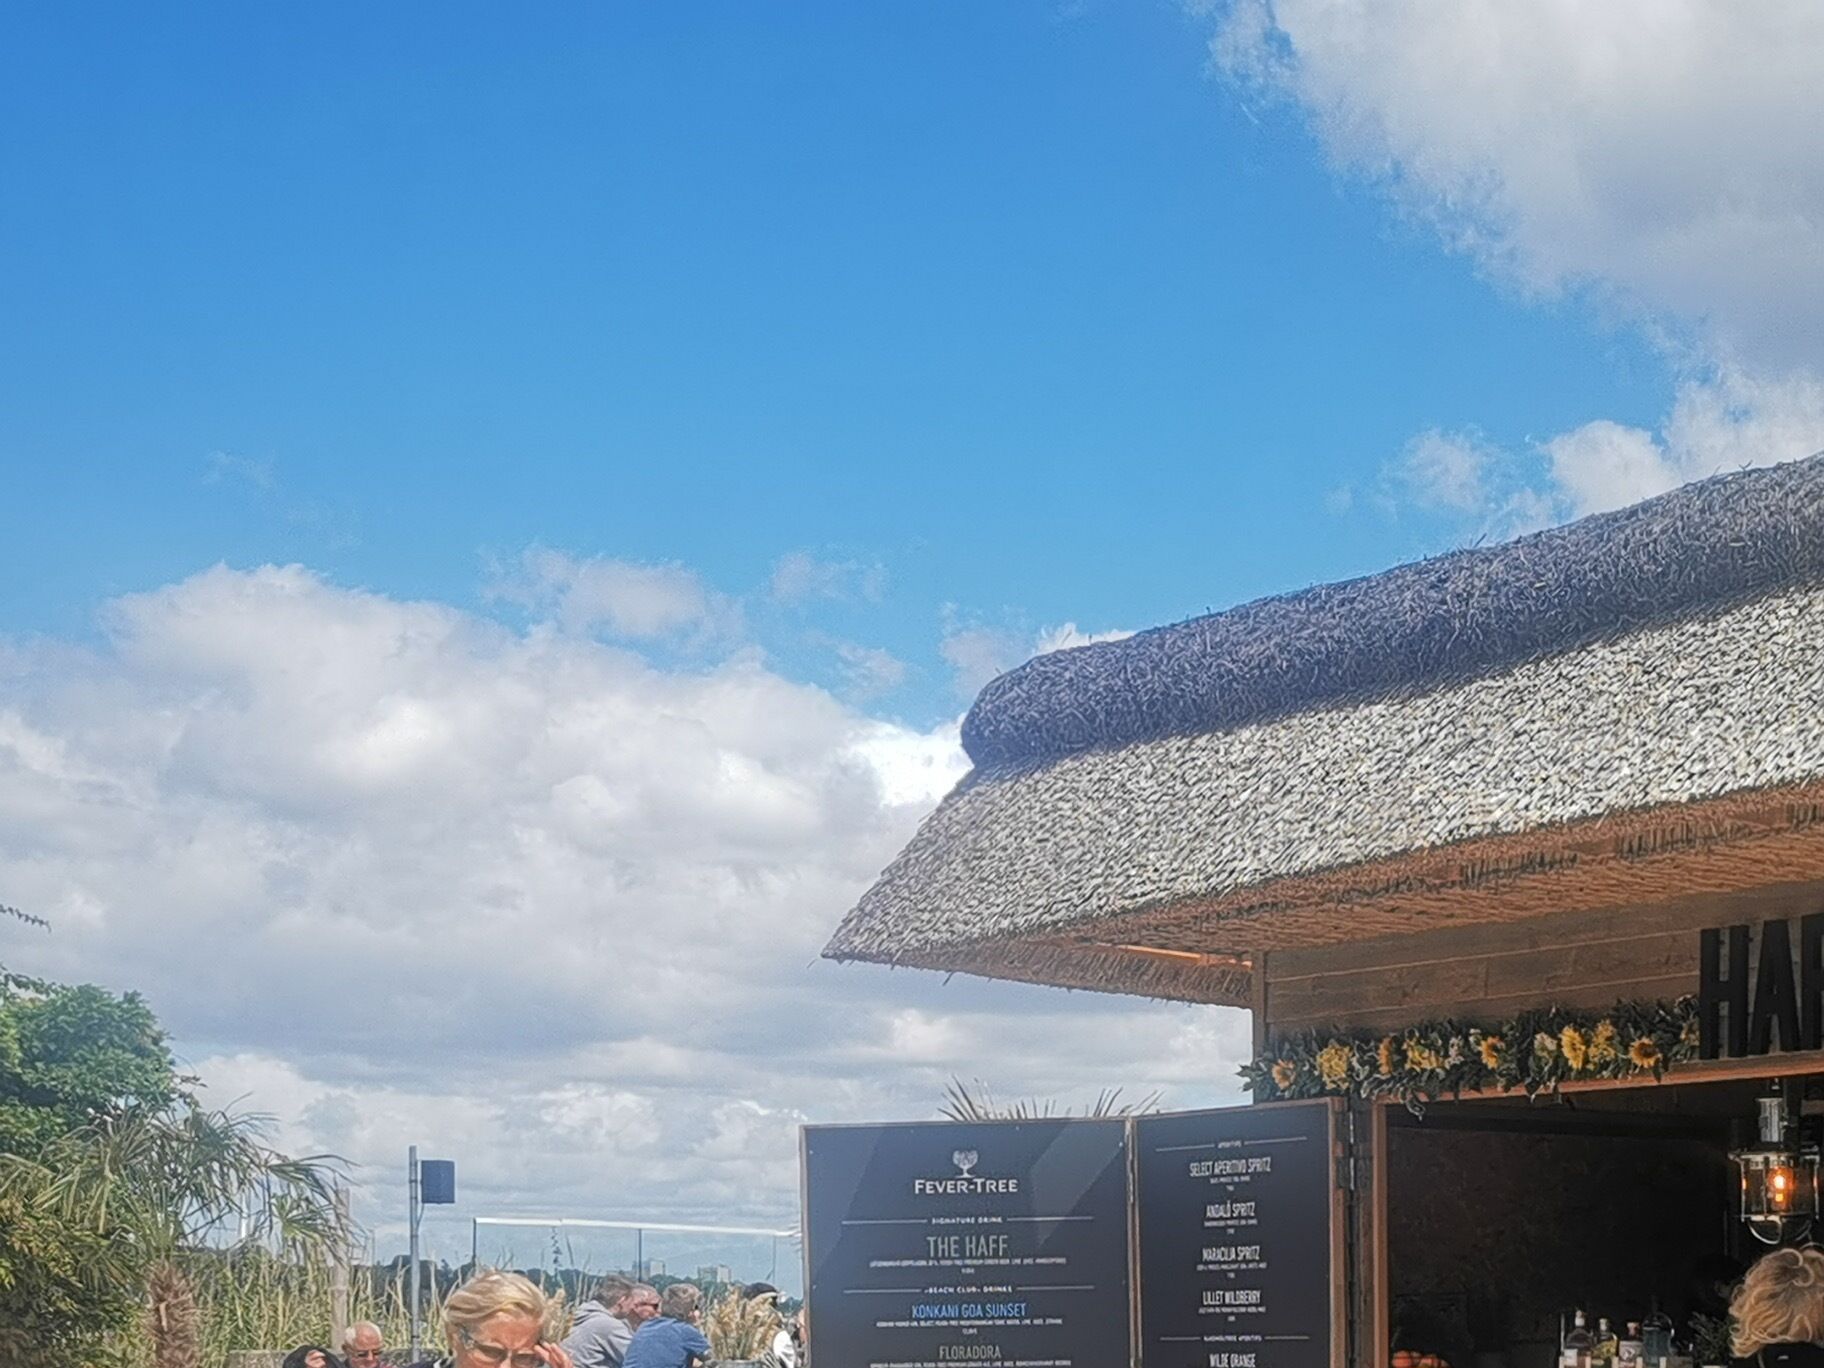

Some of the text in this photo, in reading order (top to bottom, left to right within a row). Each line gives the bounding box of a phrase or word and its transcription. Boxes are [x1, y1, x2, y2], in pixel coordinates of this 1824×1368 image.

[914, 1178, 1019, 1194] FEVER-TREE
[926, 1234, 1009, 1258] THE HAFF
[912, 1302, 1027, 1318] KONKANI GOA SUNSET
[939, 1345, 1002, 1361] FLORADORA
